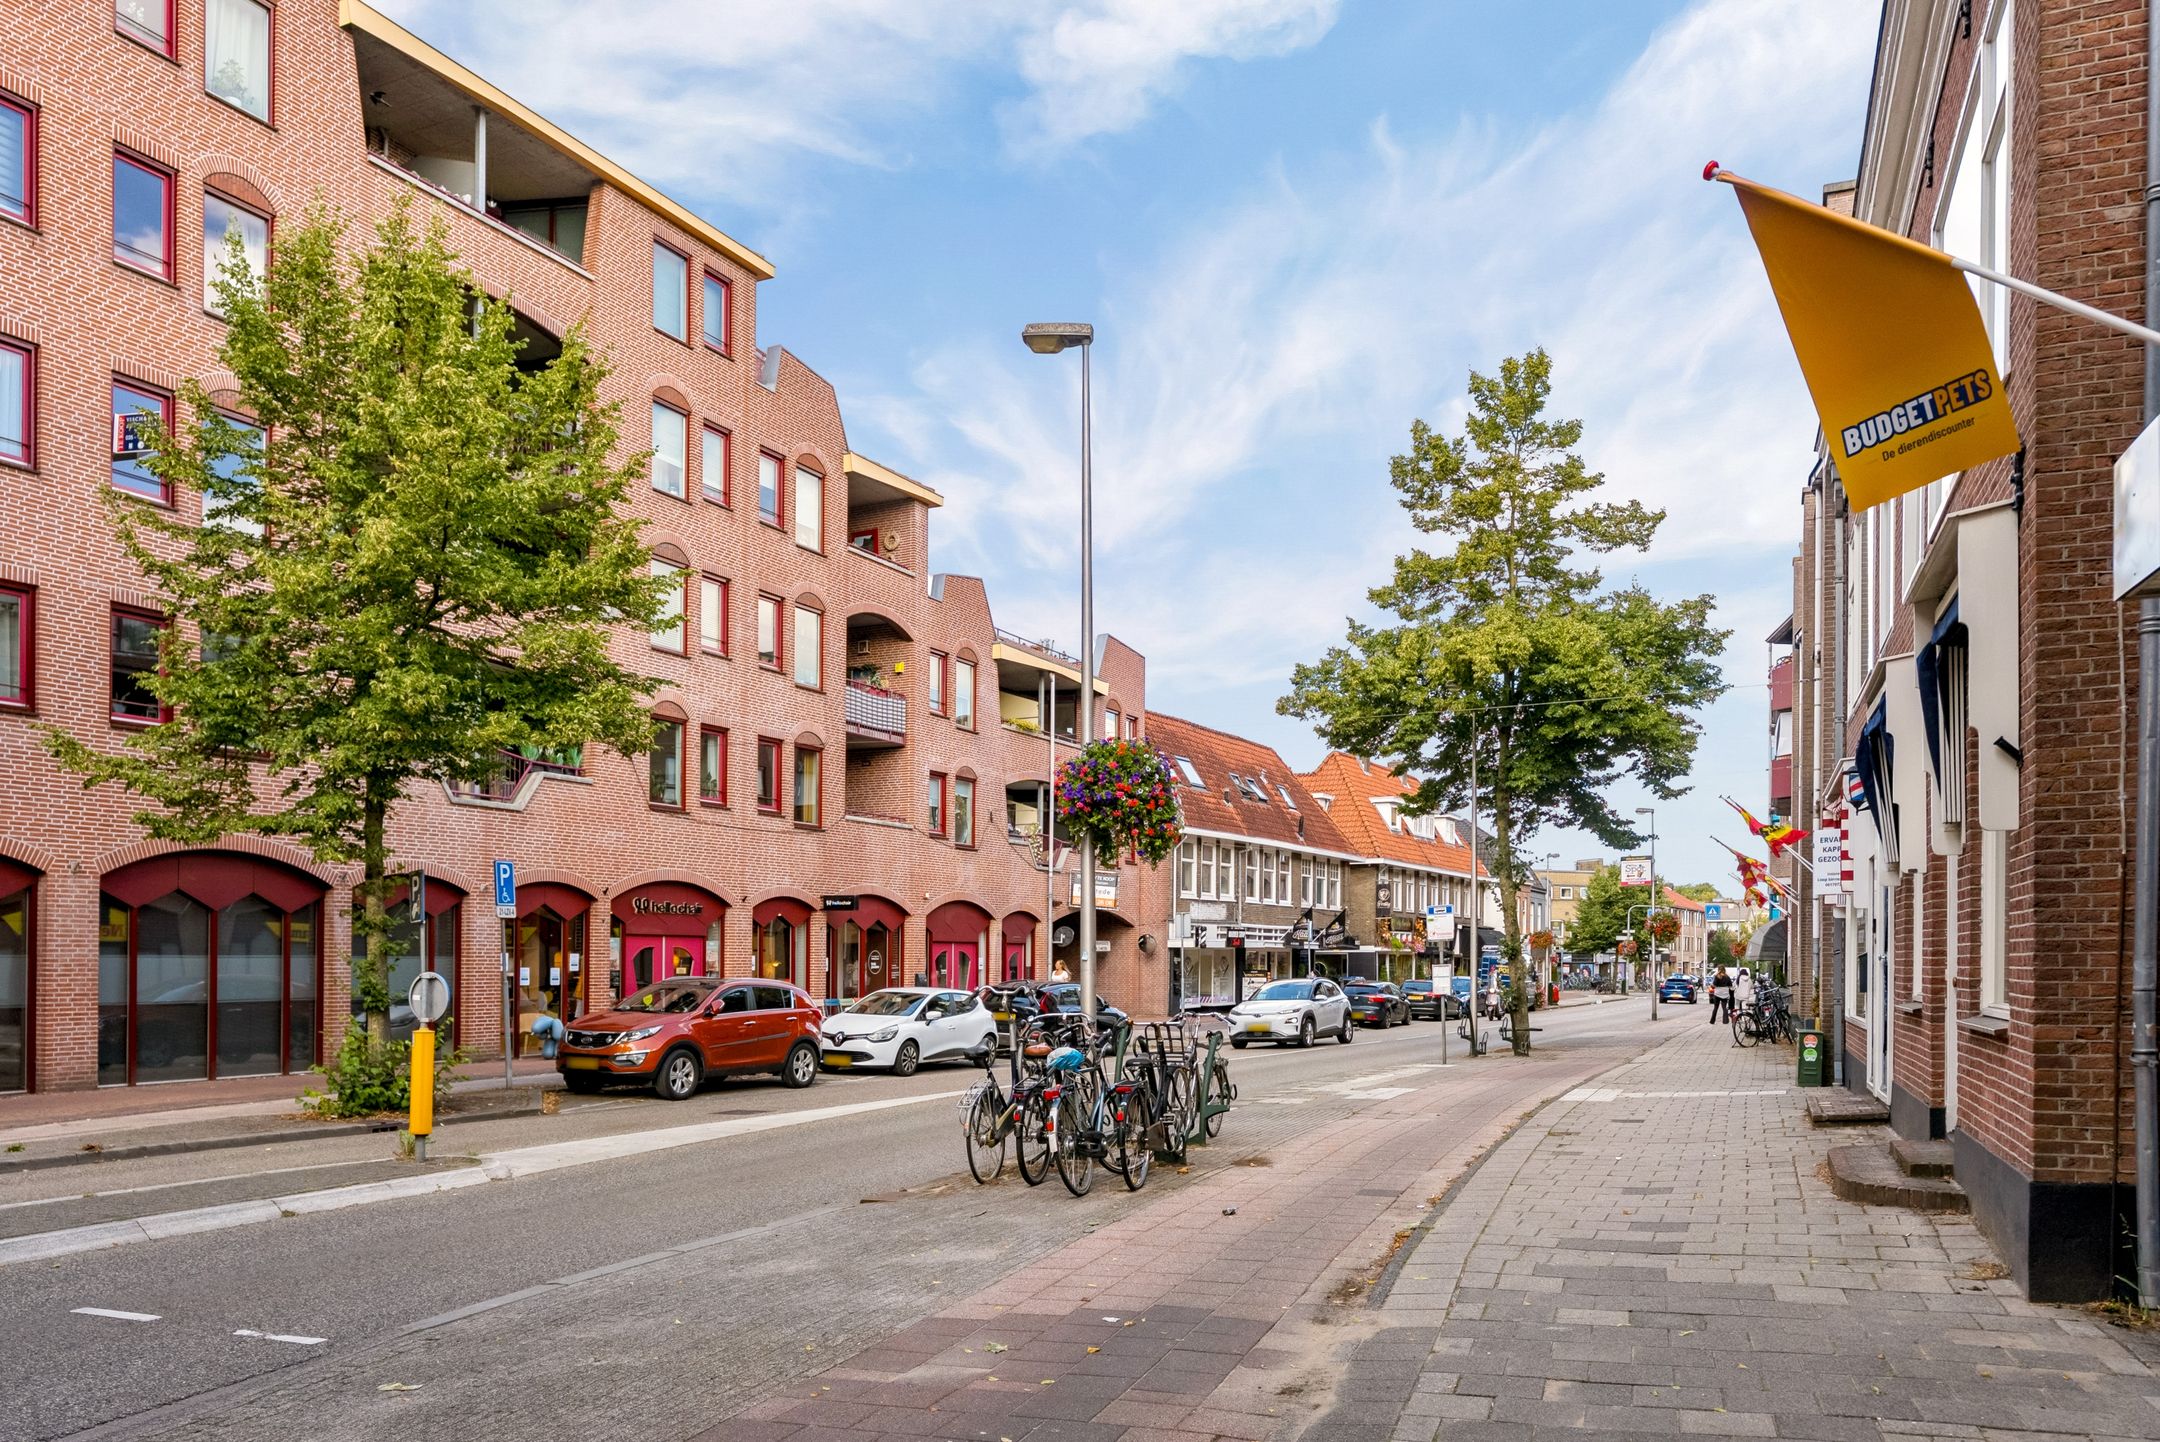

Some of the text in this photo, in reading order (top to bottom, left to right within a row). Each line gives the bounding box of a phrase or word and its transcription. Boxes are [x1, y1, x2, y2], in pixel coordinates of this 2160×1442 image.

[1842, 369, 1993, 457] BUDGETPETS
[1882, 416, 1976, 462] De dierendiscounter
[499, 864, 510, 887] P
[649, 900, 704, 915] hellochair
